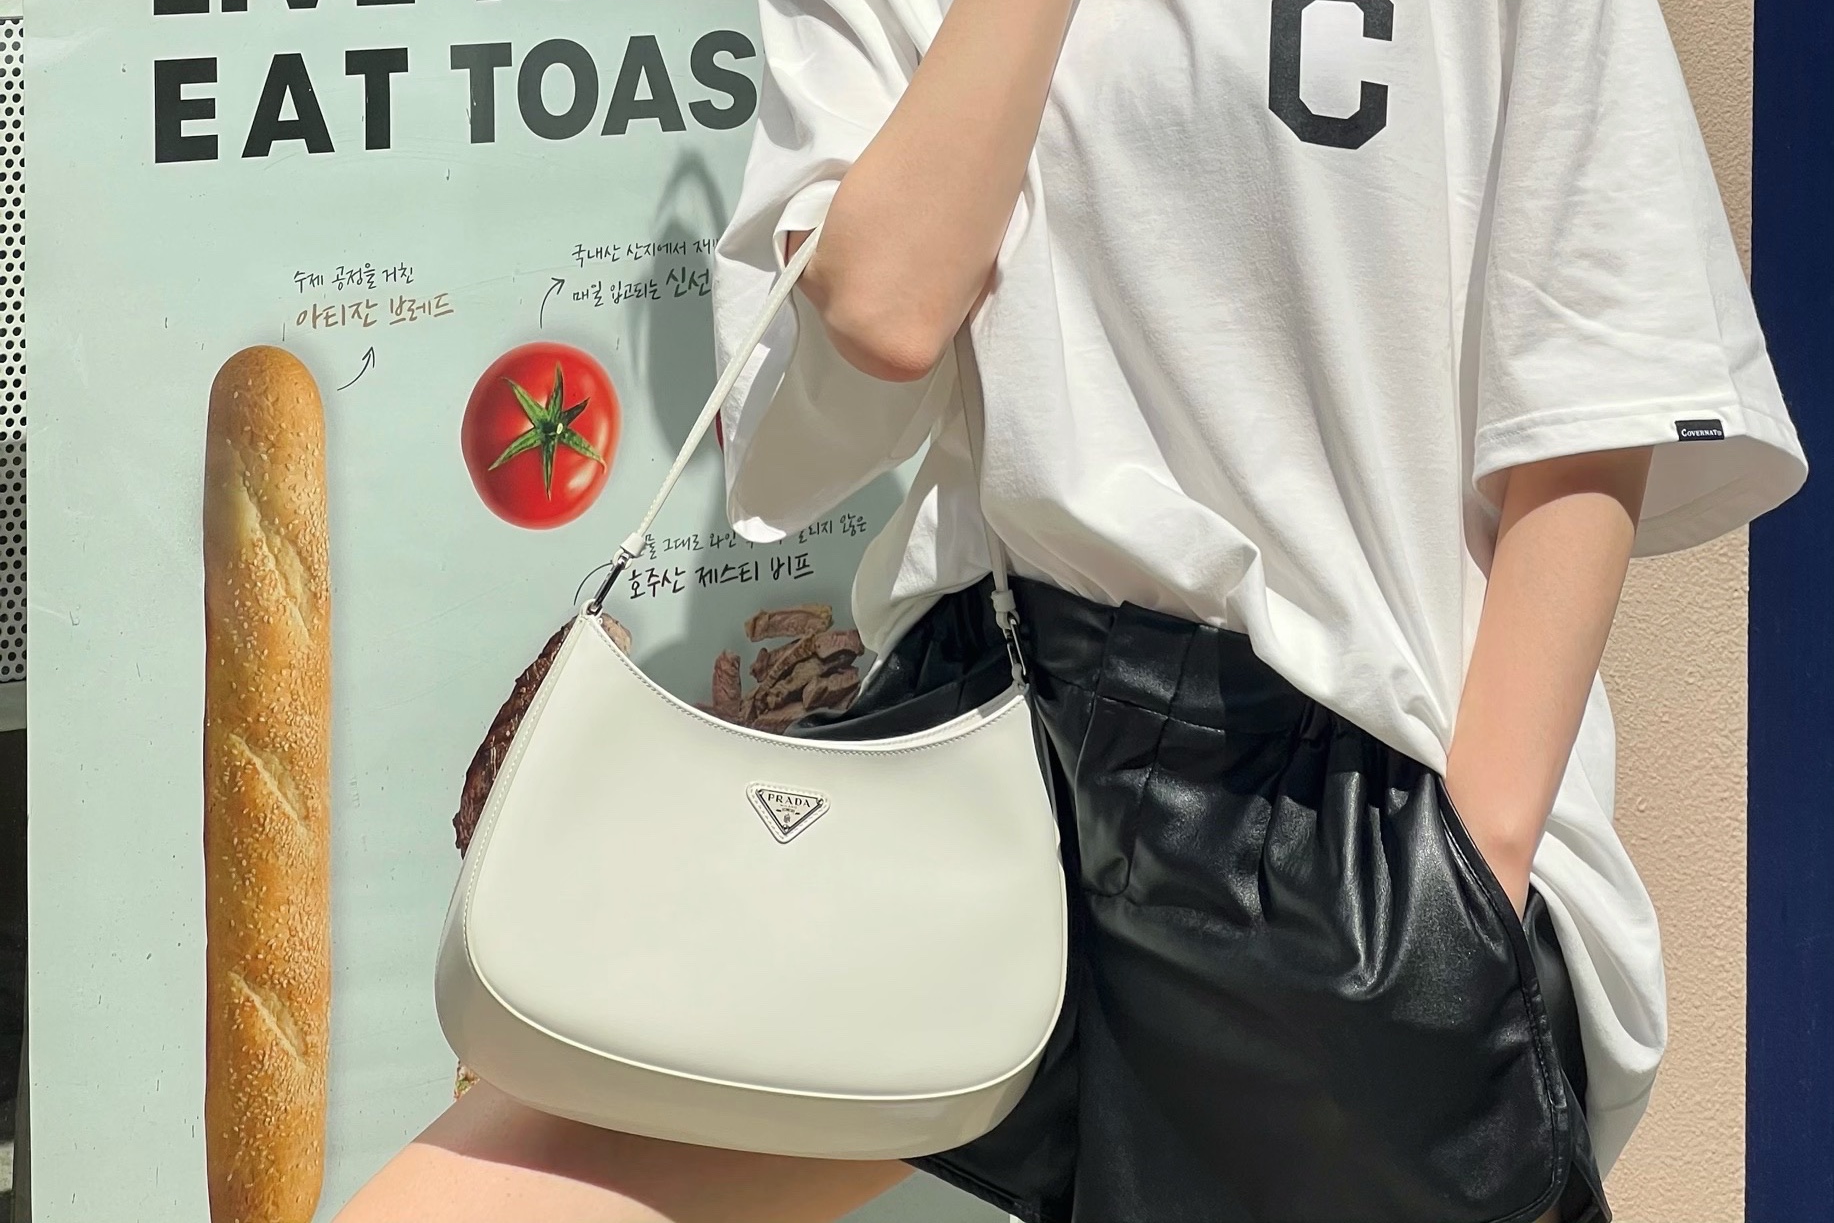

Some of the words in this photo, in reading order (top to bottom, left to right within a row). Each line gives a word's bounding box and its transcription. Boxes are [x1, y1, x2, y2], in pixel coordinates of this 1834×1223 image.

[154, 47, 409, 164] EAT
[571, 243, 622, 268] 국내산
[626, 241, 687, 261] 산지에서
[293, 270, 324, 293] 수제
[332, 262, 377, 291] 공정을
[382, 261, 415, 284] 거친
[572, 280, 604, 308] 매일
[610, 278, 662, 304] 입고되는
[295, 298, 379, 329] 아티잔
[389, 292, 455, 326] 브레드
[662, 533, 704, 552] 그대로
[839, 513, 868, 537] 않은
[628, 566, 687, 600] 호주산
[695, 560, 759, 588] 제스티
[770, 553, 815, 581] 비프
[768, 793, 811, 808] PRADA
